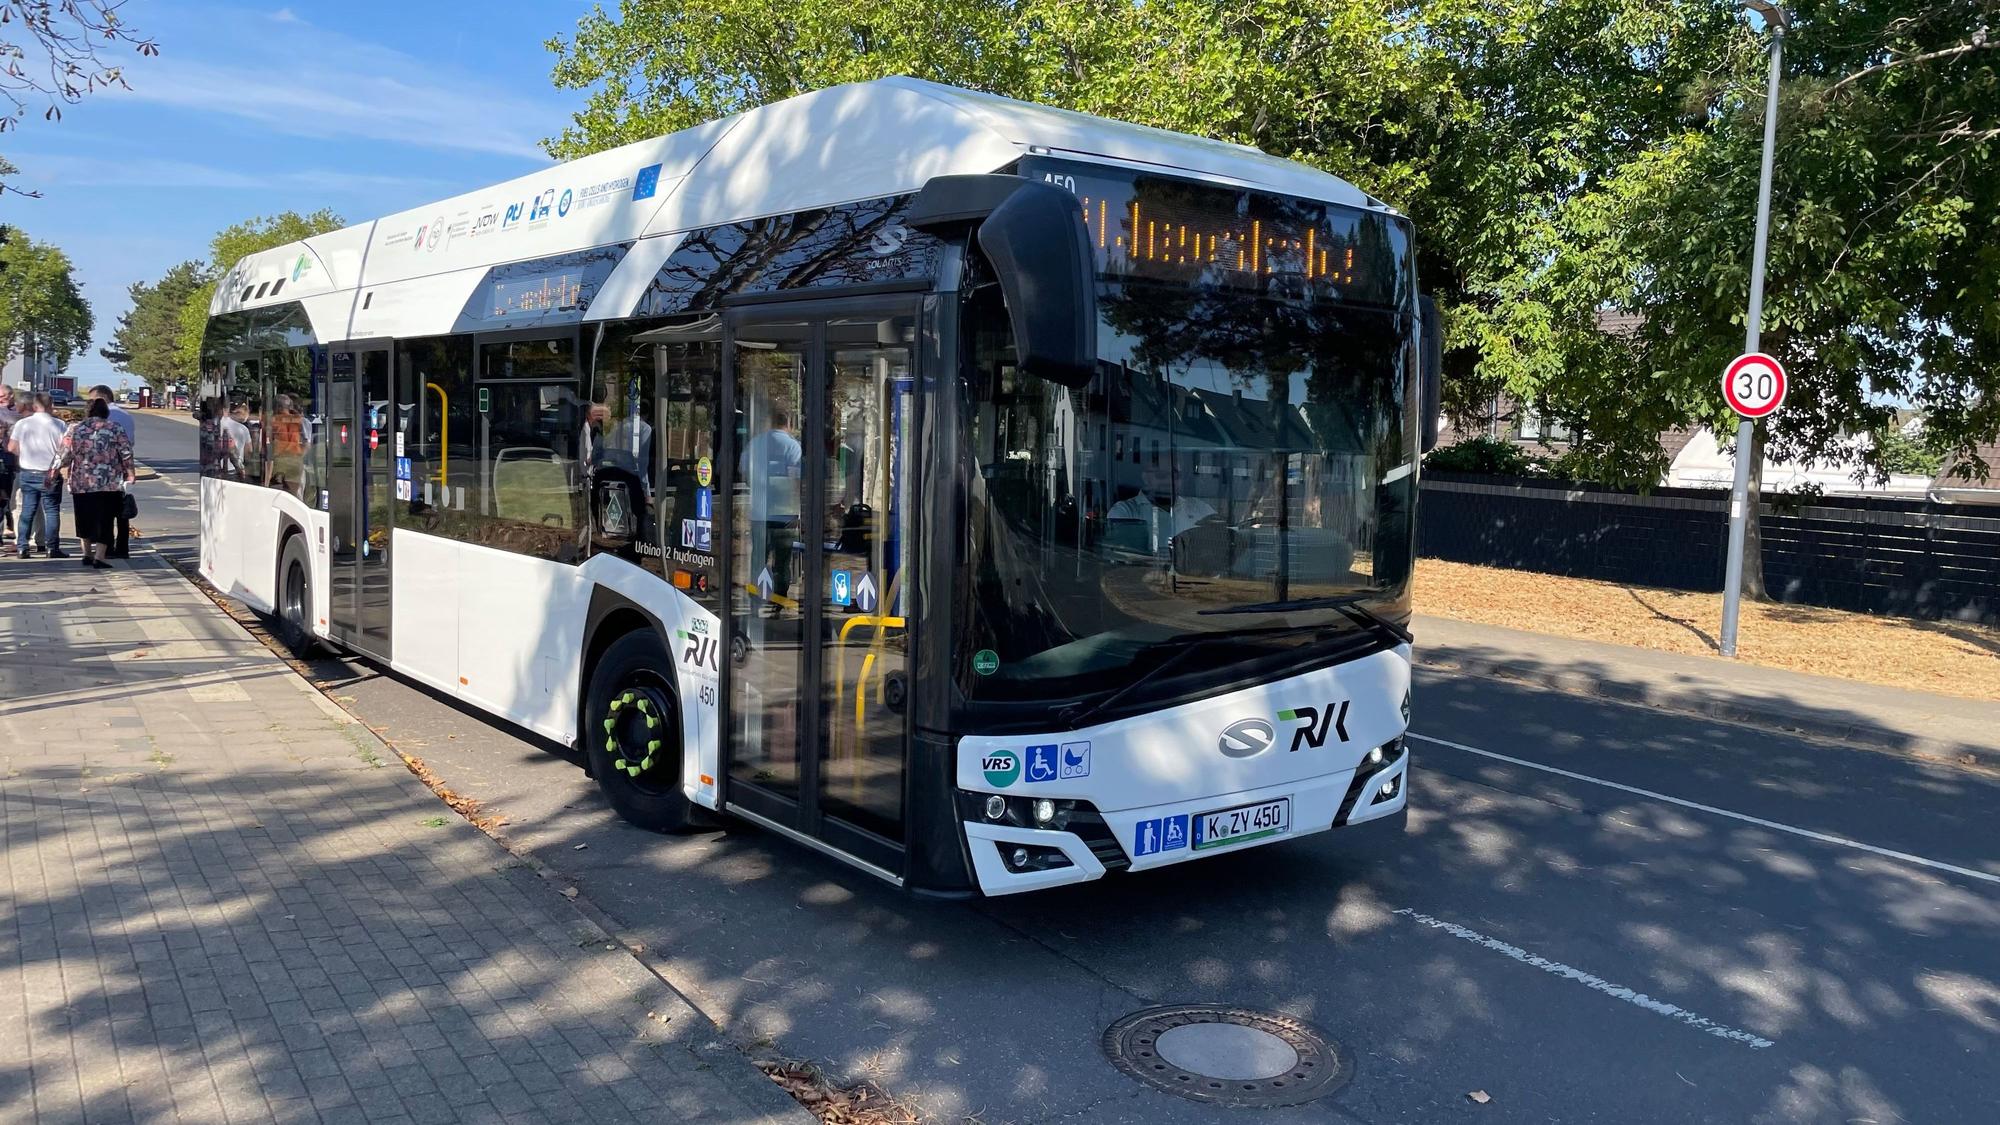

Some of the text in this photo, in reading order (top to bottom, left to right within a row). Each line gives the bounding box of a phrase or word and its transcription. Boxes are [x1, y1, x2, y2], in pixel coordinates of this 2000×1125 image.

[1738, 373, 1772, 400] 30
[635, 540, 661, 557] Urbino
[673, 547, 714, 568] hydrogen
[699, 684, 715, 707] 450
[981, 757, 1012, 771] VRS
[1209, 804, 1281, 840] K ZY 450
